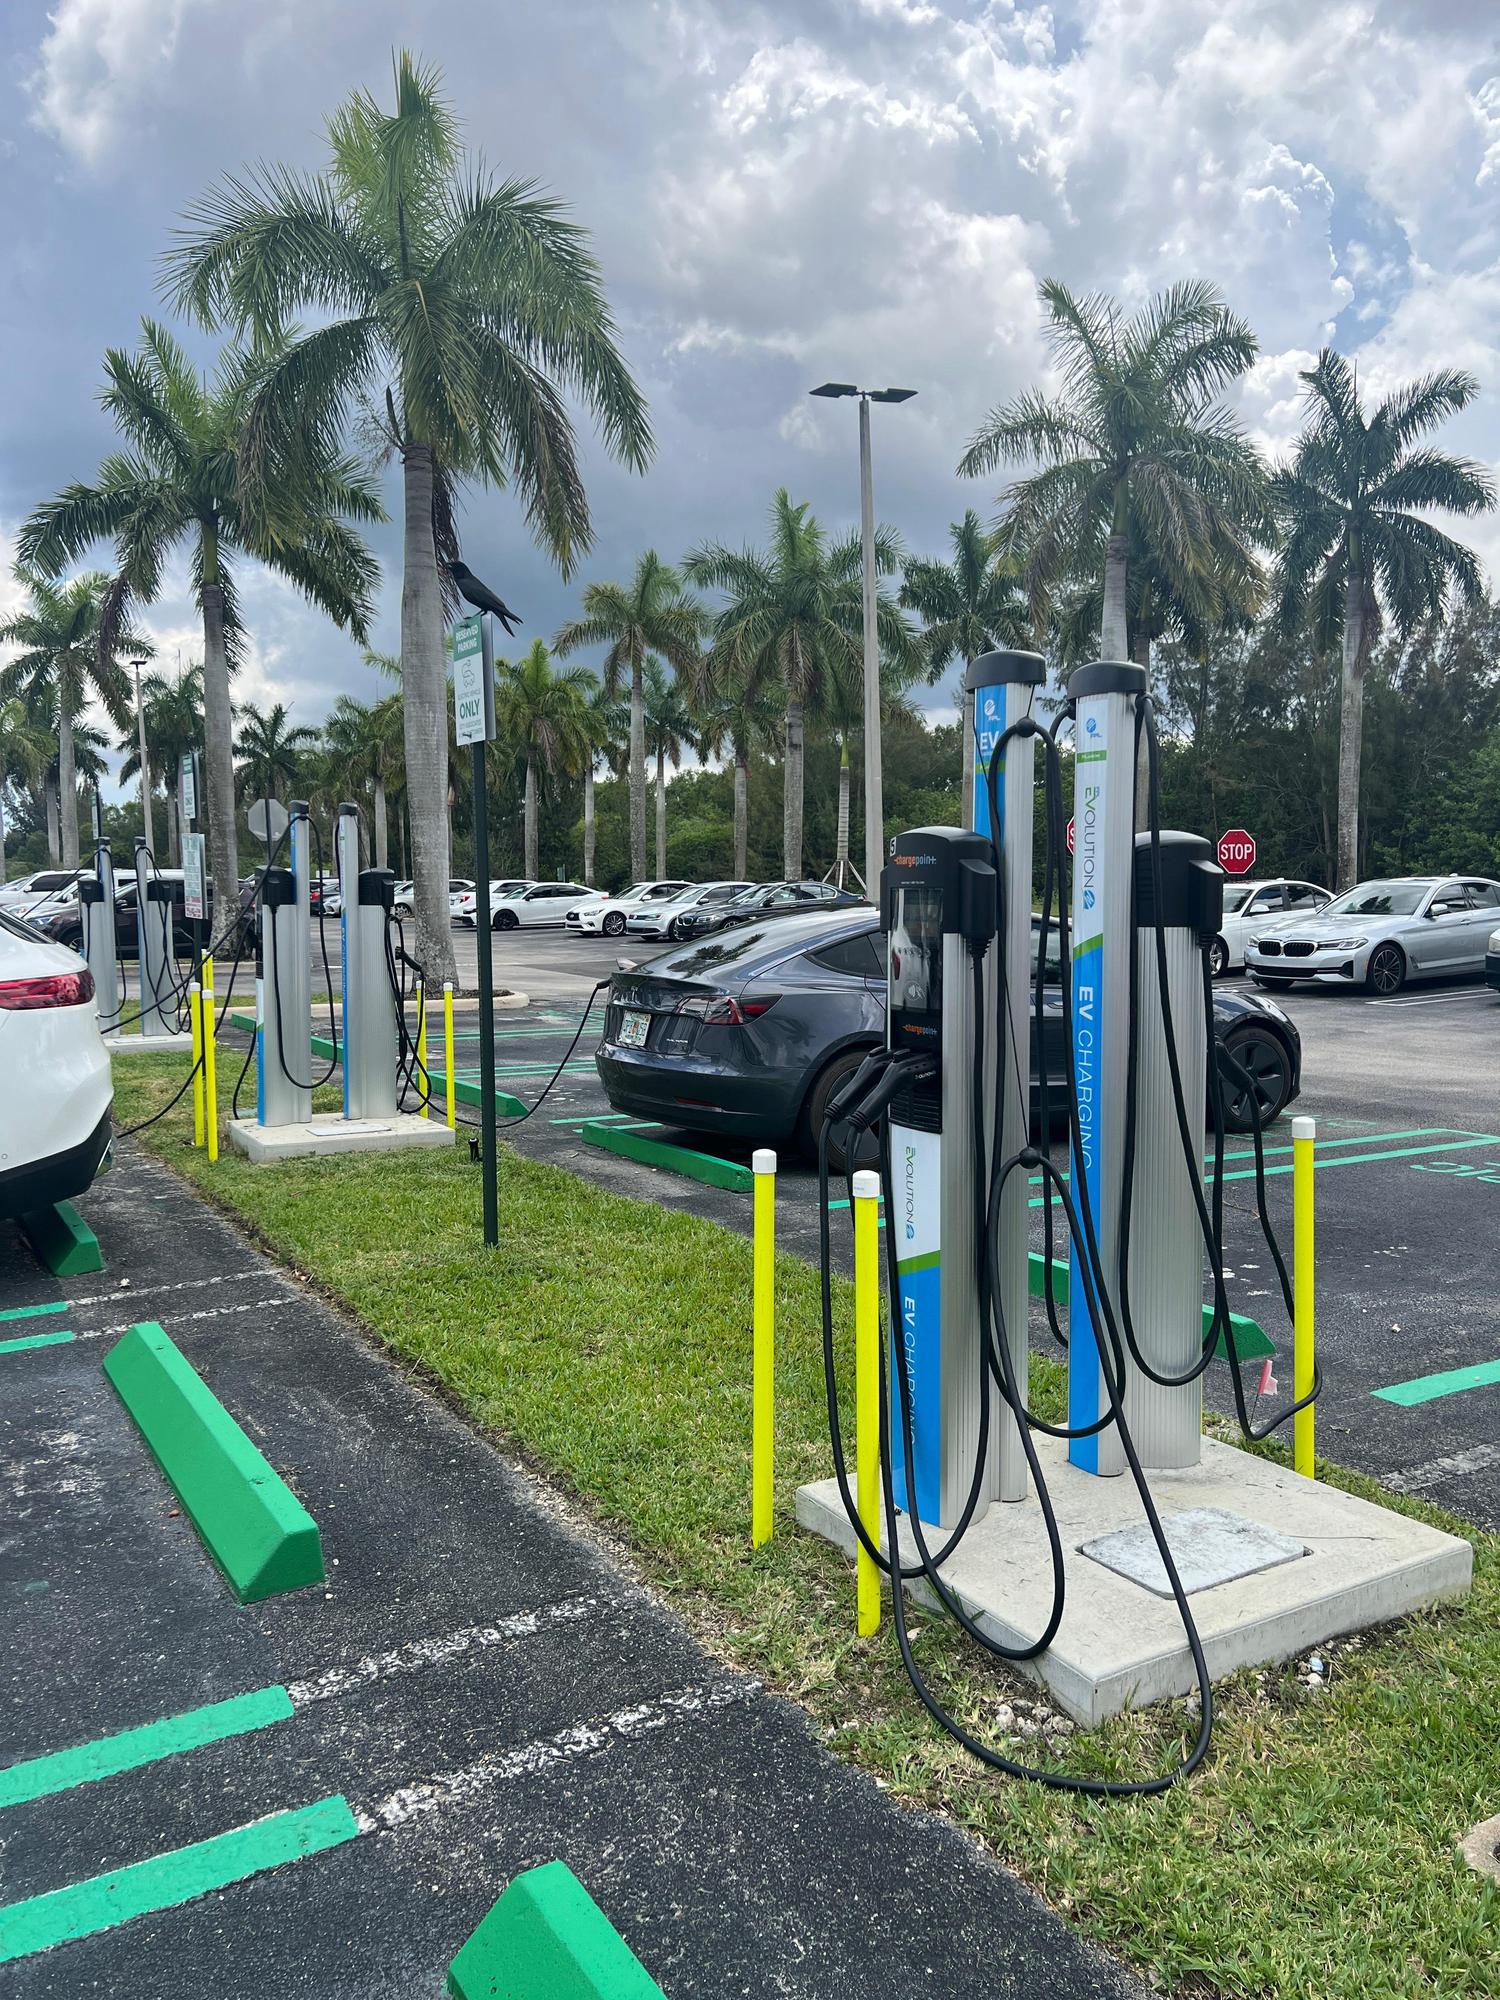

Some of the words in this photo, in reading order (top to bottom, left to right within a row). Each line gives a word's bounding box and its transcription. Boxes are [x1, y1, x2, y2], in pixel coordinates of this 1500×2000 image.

[460, 698, 480, 719] ONLY
[980, 731, 1000, 750] EV
[1220, 843, 1253, 860] STOP
[1079, 985, 1094, 1021] EV
[905, 1146, 915, 1224] EVOLUTION
[904, 1296, 916, 1327] EV
